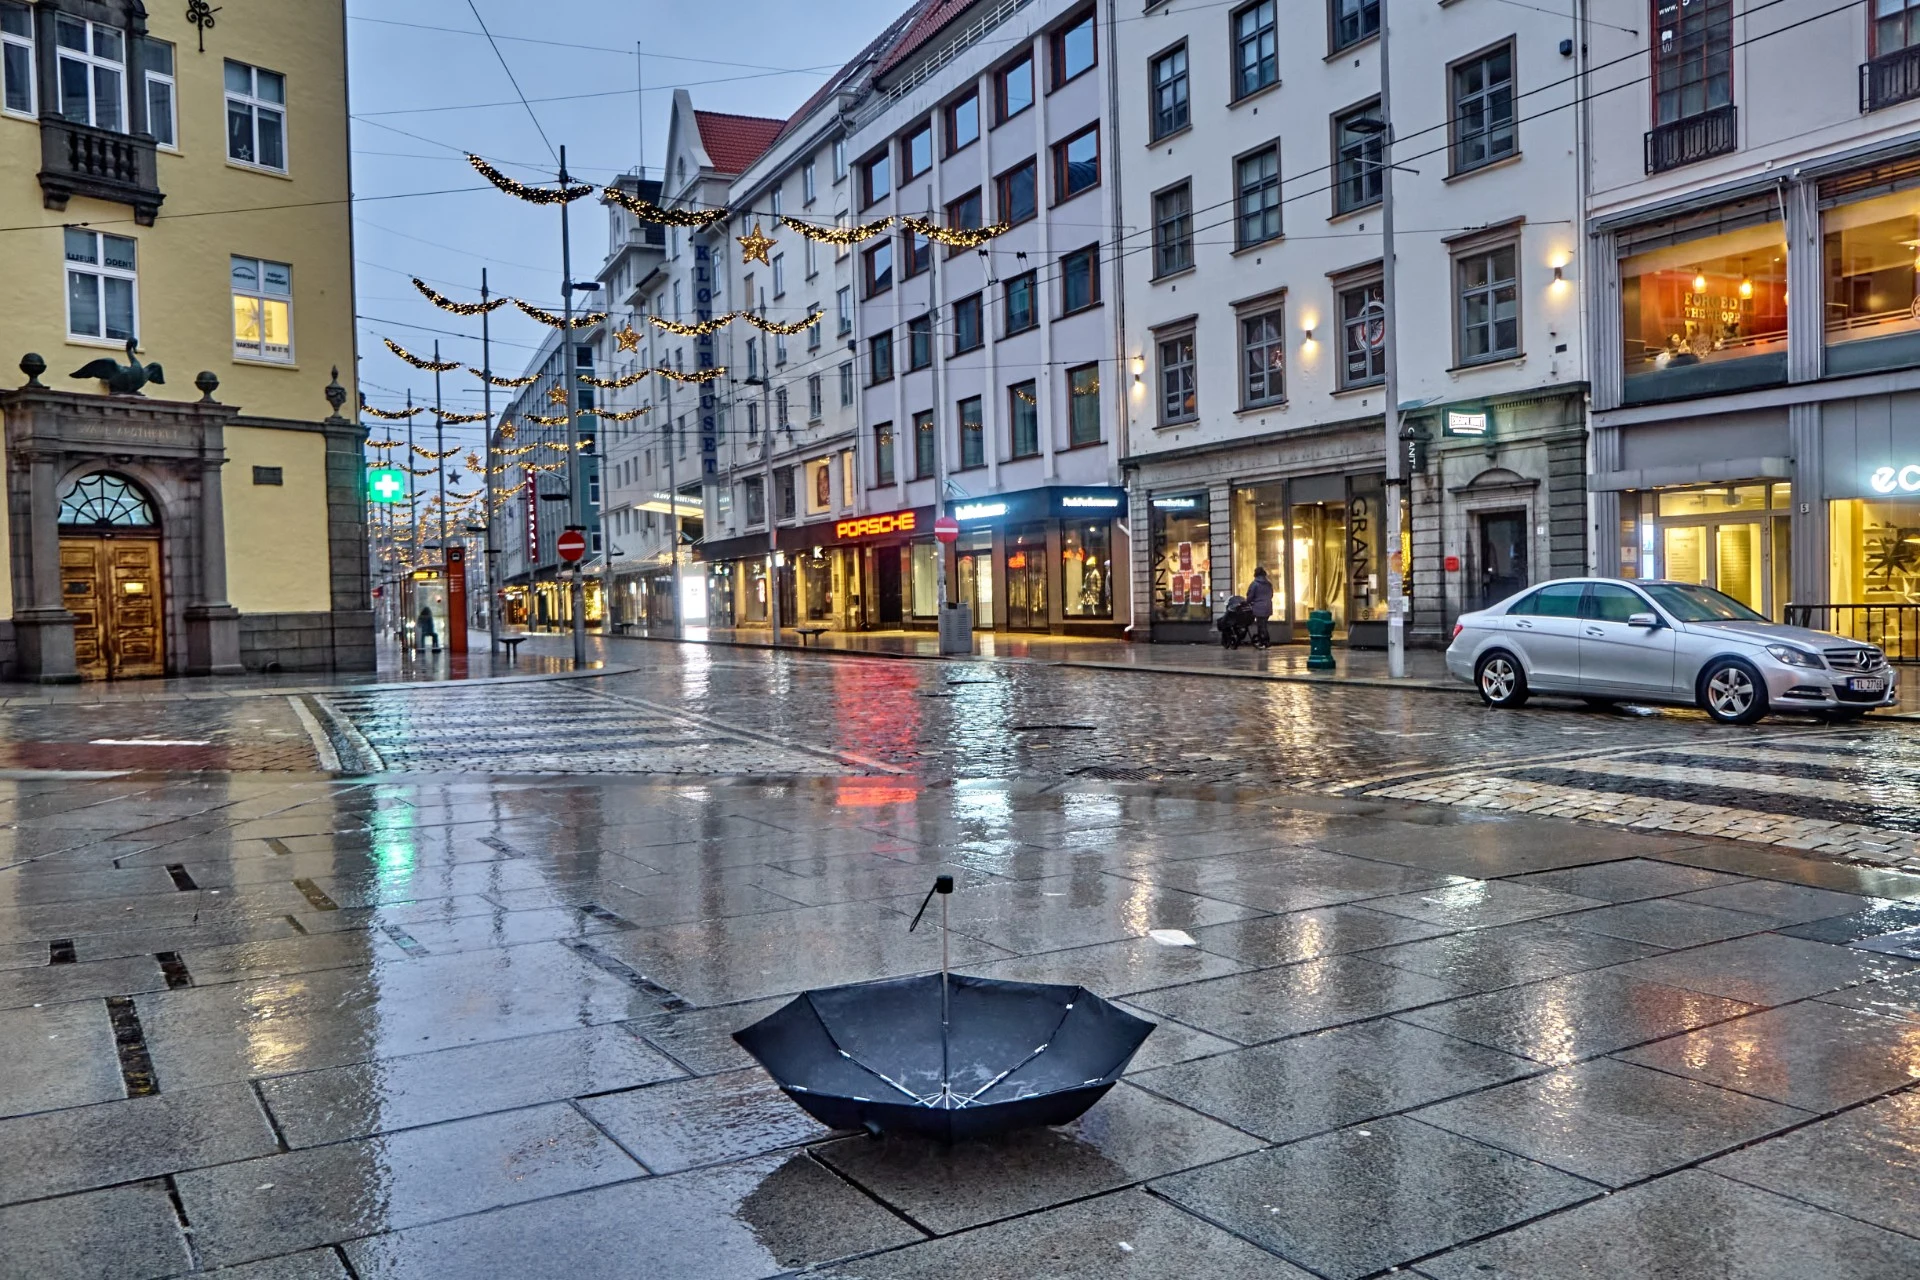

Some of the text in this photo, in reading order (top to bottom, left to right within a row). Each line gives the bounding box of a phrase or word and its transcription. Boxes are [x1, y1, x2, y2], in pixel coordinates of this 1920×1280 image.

[1684, 307, 1706, 319] THE
[695, 245, 717, 474] KLØVERUSET
[837, 512, 916, 539] PORSCHE
[1352, 497, 1369, 607] GRANIT
